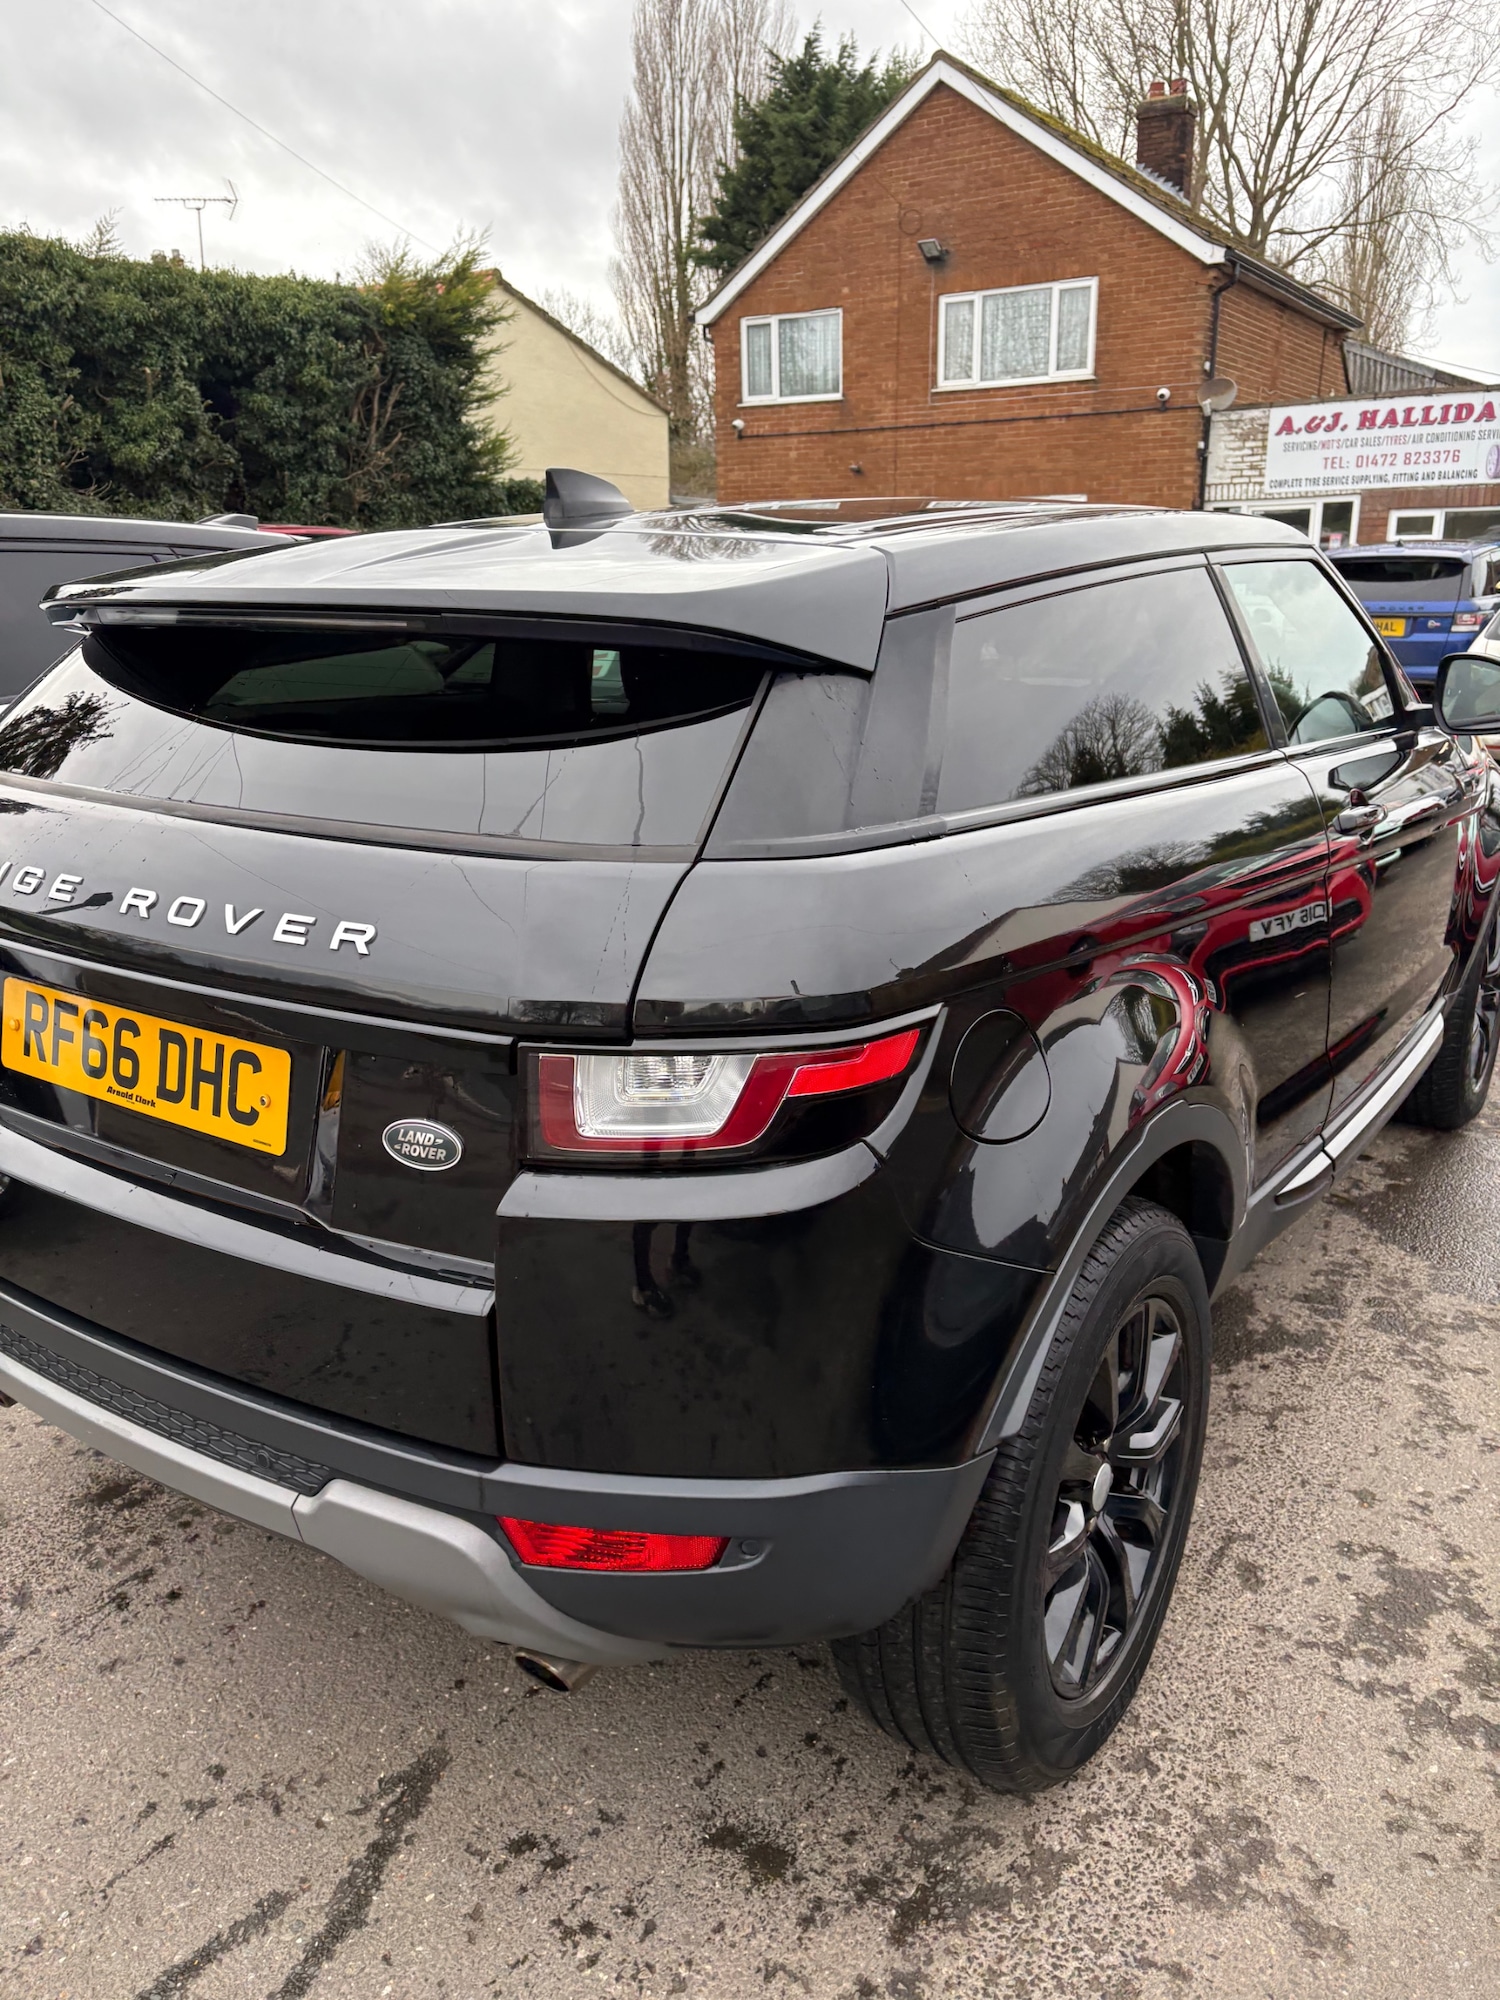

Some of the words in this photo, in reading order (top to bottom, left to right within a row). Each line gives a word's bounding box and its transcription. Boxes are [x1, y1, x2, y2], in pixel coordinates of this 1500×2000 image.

[1356, 400, 1500, 431] HALLIDA
[1425, 429, 1476, 444] CONDITIONING
[1478, 428, 1500, 441] SERVI
[1323, 456, 1350, 470] TEL:
[1355, 452, 1397, 469] 01472
[1403, 449, 1461, 466] 823376
[1269, 477, 1303, 489] COMPLETE
[1305, 476, 1320, 488] TYRE
[1322, 475, 1350, 487] SERVICE
[1351, 473, 1390, 485] SUPPLYING,
[1392, 472, 1419, 483] FITTING
[1421, 471, 1435, 481] AND
[1437, 469, 1478, 480] BALANCING
[118, 886, 378, 956] ROVER
[23, 990, 141, 1090] RF66
[156, 1027, 262, 1127] DHC
[106, 1085, 134, 1101] Arnold
[135, 1094, 157, 1109] Clark
[397, 1128, 435, 1146] LAND
[401, 1142, 447, 1161] ROVER
